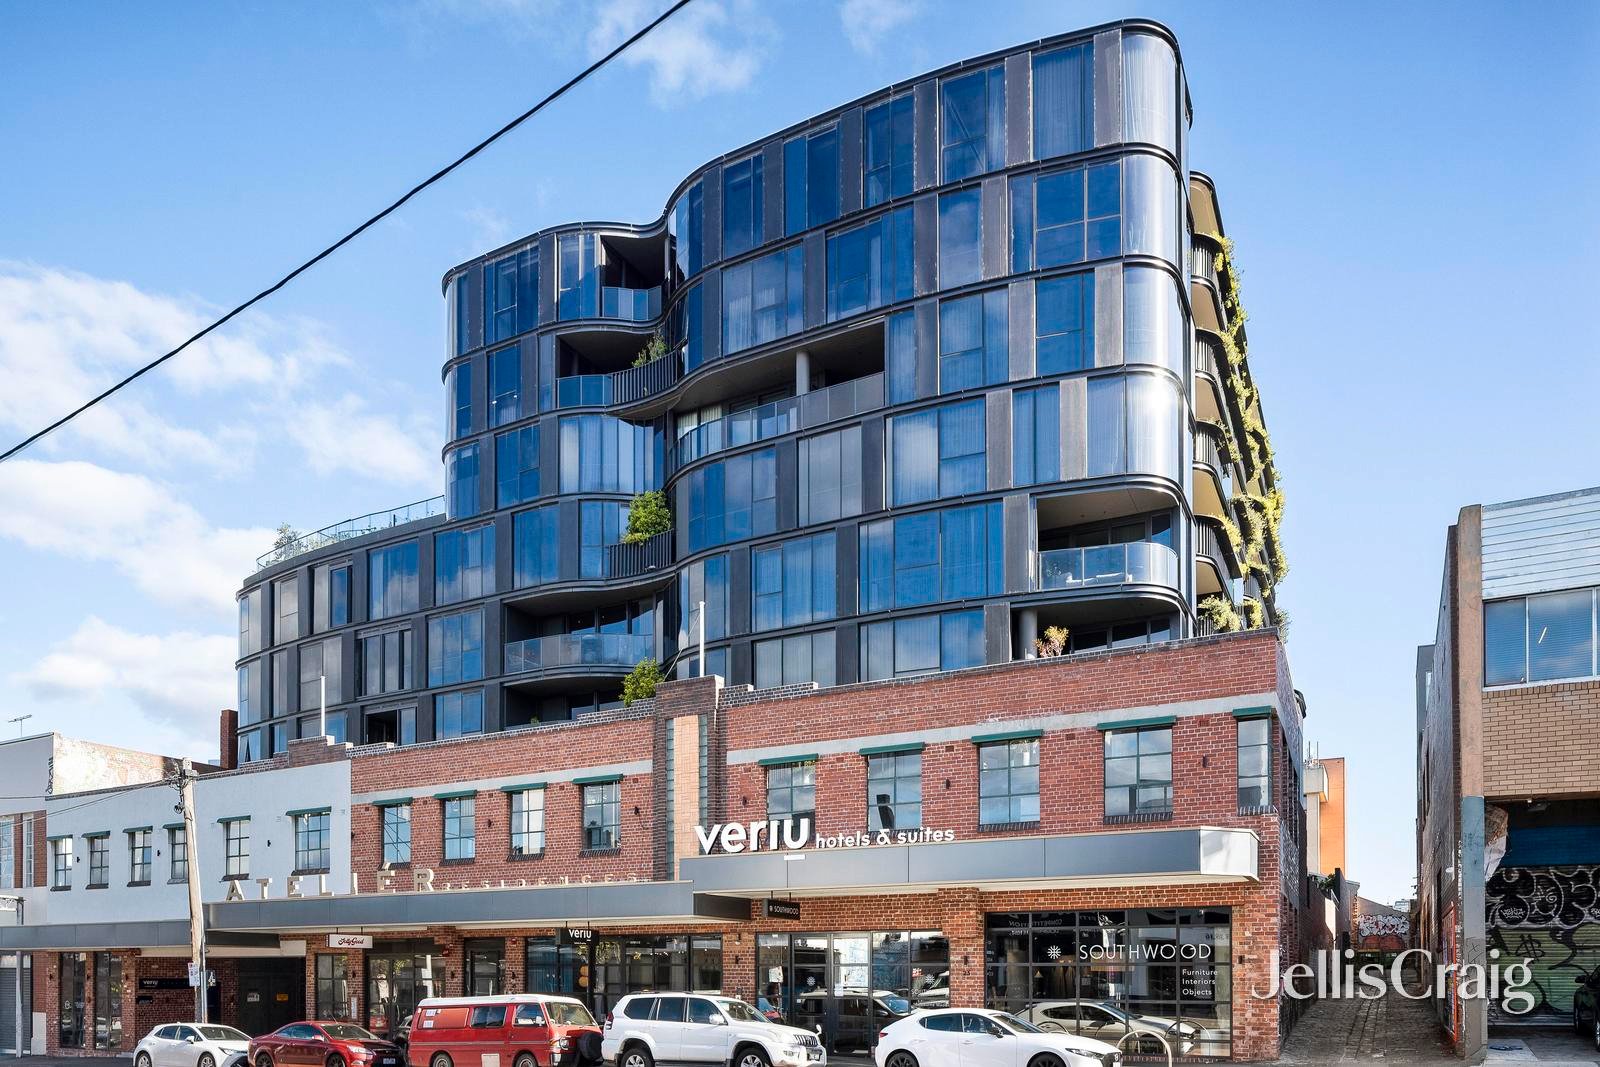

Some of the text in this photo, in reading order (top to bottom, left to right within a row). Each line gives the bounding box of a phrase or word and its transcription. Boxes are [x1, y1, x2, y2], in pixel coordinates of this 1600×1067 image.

[694, 818, 955, 855] veriu hotels & suites
[773, 905, 799, 915] SOUTHWOOD
[568, 928, 592, 940] veriu
[1079, 944, 1212, 960] SOUTHWOOD
[1182, 968, 1218, 976] Furniture
[1182, 988, 1212, 996] Objects
